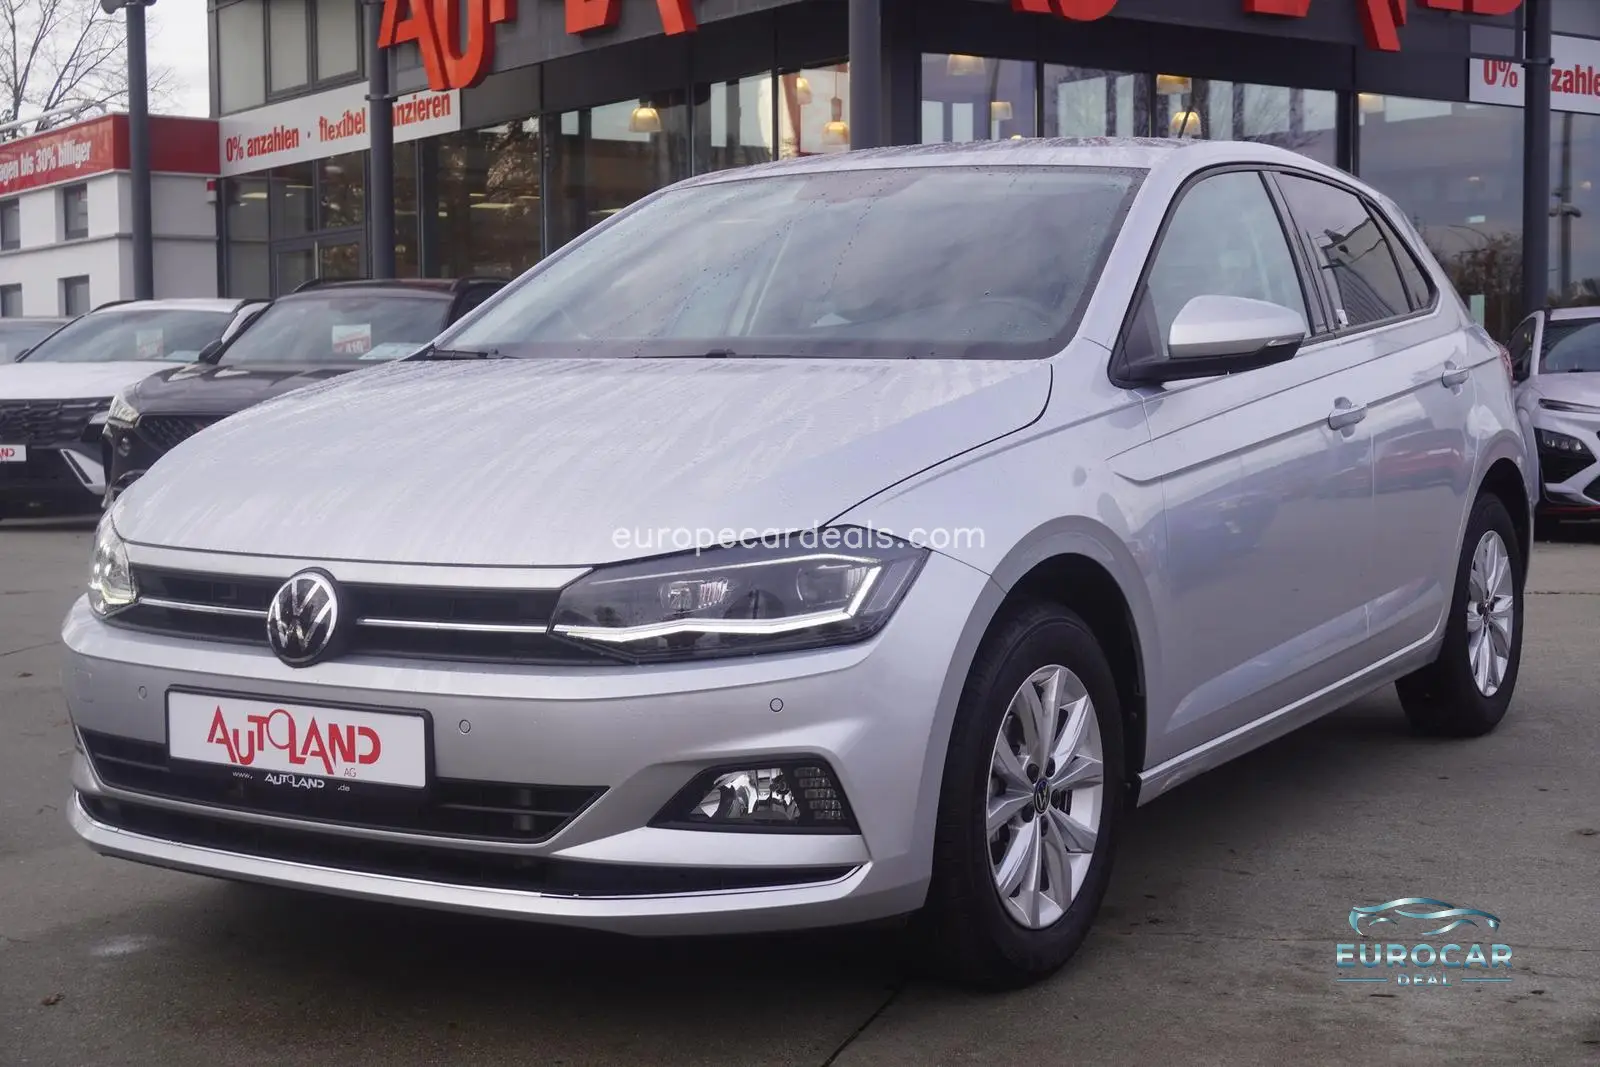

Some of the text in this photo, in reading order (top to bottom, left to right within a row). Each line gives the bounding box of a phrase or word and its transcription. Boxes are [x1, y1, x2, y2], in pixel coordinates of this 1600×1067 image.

[1483, 58, 1518, 88] 0%
[225, 135, 244, 162] 0%
[247, 126, 300, 158] anzahlen
[319, 107, 366, 142] flexibel
[20, 151, 34, 176] bis
[35, 143, 57, 173] 30%
[58, 138, 92, 169] billiger
[232, 769, 254, 780] www.
[343, 767, 357, 779] AG
